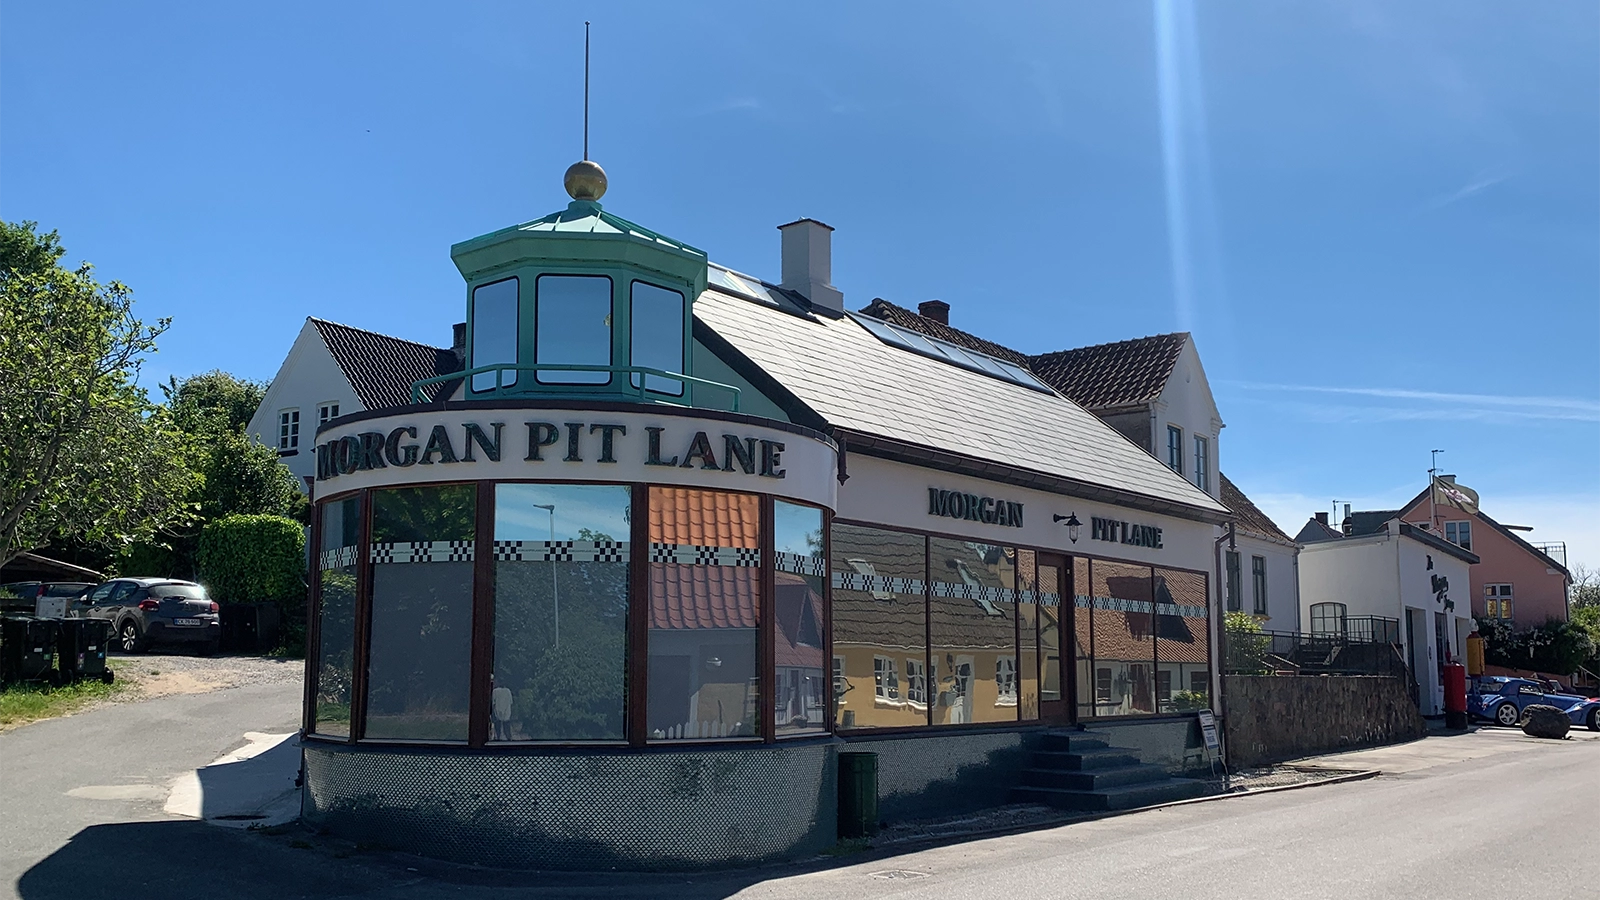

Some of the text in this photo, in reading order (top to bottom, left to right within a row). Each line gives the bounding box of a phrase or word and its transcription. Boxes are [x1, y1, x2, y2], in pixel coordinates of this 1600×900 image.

[316, 422, 787, 481] MORGAN PIT LANE
[928, 487, 1164, 549] MORGAN PIT LANE
